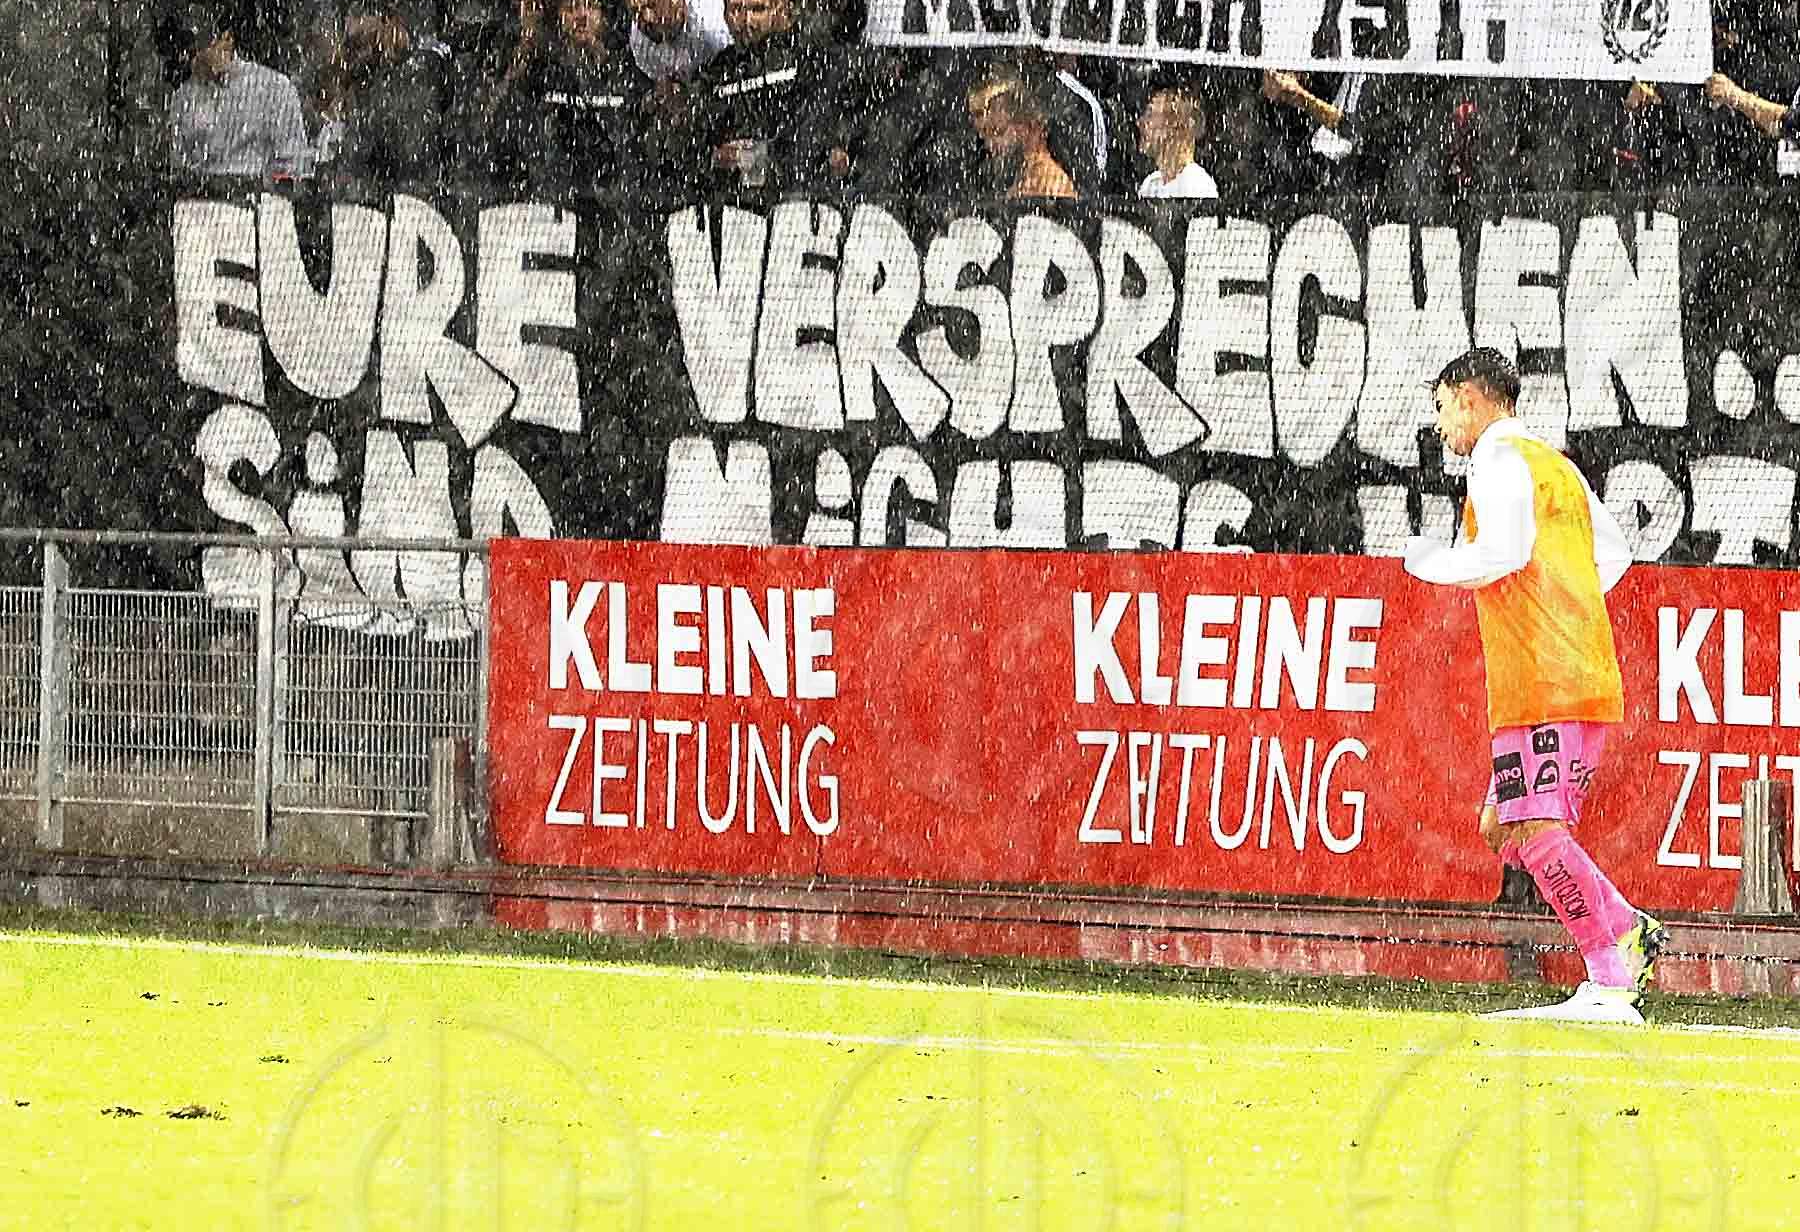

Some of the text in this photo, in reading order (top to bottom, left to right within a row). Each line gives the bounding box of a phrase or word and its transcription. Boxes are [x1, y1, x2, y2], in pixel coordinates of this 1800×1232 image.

[170, 192, 582, 447] EURE
[548, 581, 838, 699] KLEINE
[1072, 592, 1384, 711] KLEINE
[545, 714, 840, 837] ZEITUNG
[1076, 731, 1368, 854] ZEITUNG
